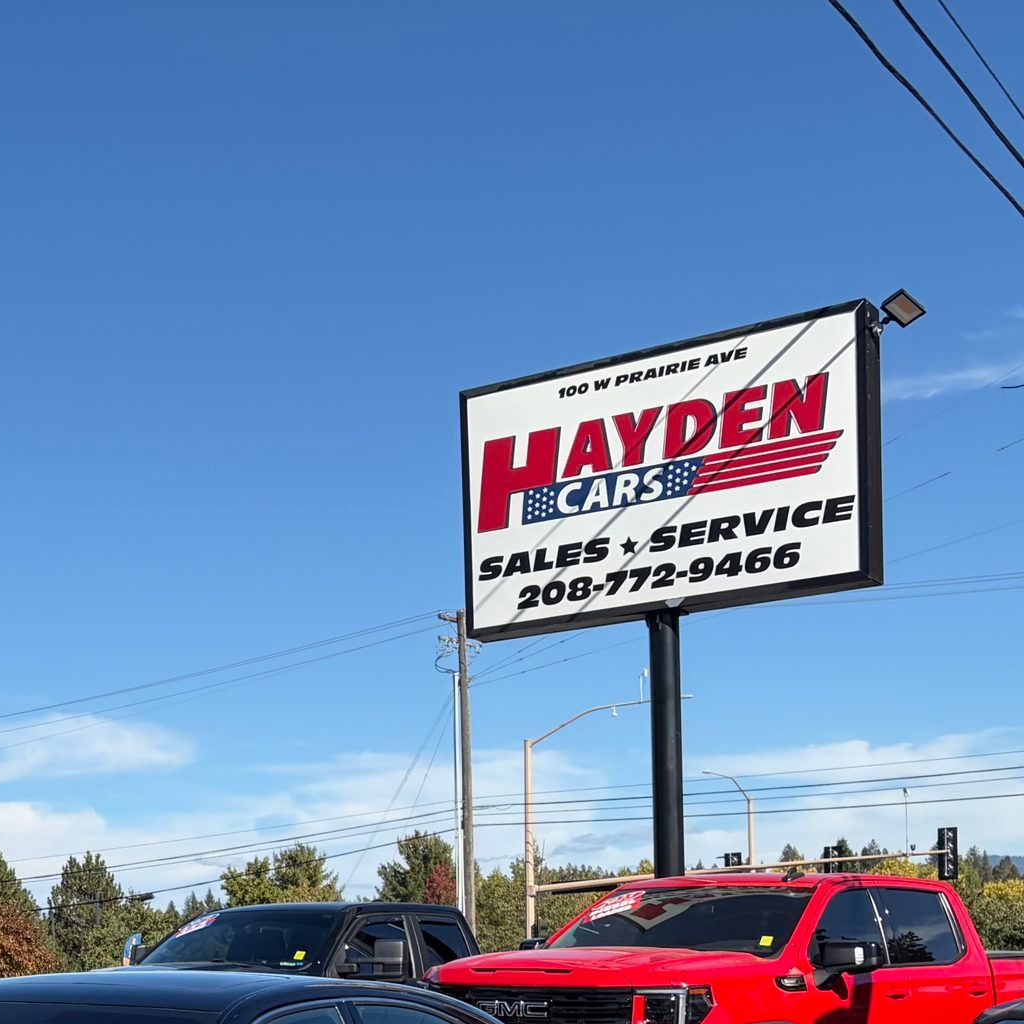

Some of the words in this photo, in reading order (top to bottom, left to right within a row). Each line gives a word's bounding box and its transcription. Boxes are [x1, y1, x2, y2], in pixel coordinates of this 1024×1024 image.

[558, 383, 588, 399] 100
[593, 377, 611, 392] W
[614, 358, 701, 387] PRAIRIE
[704, 347, 748, 366] AVE
[478, 371, 830, 535] HAYDEN
[556, 471, 665, 515] CARS
[478, 537, 610, 581] SALES
[649, 495, 856, 553] SERVICE
[516, 542, 801, 610] 208-772-9466
[477, 1000, 548, 1018] GMC
